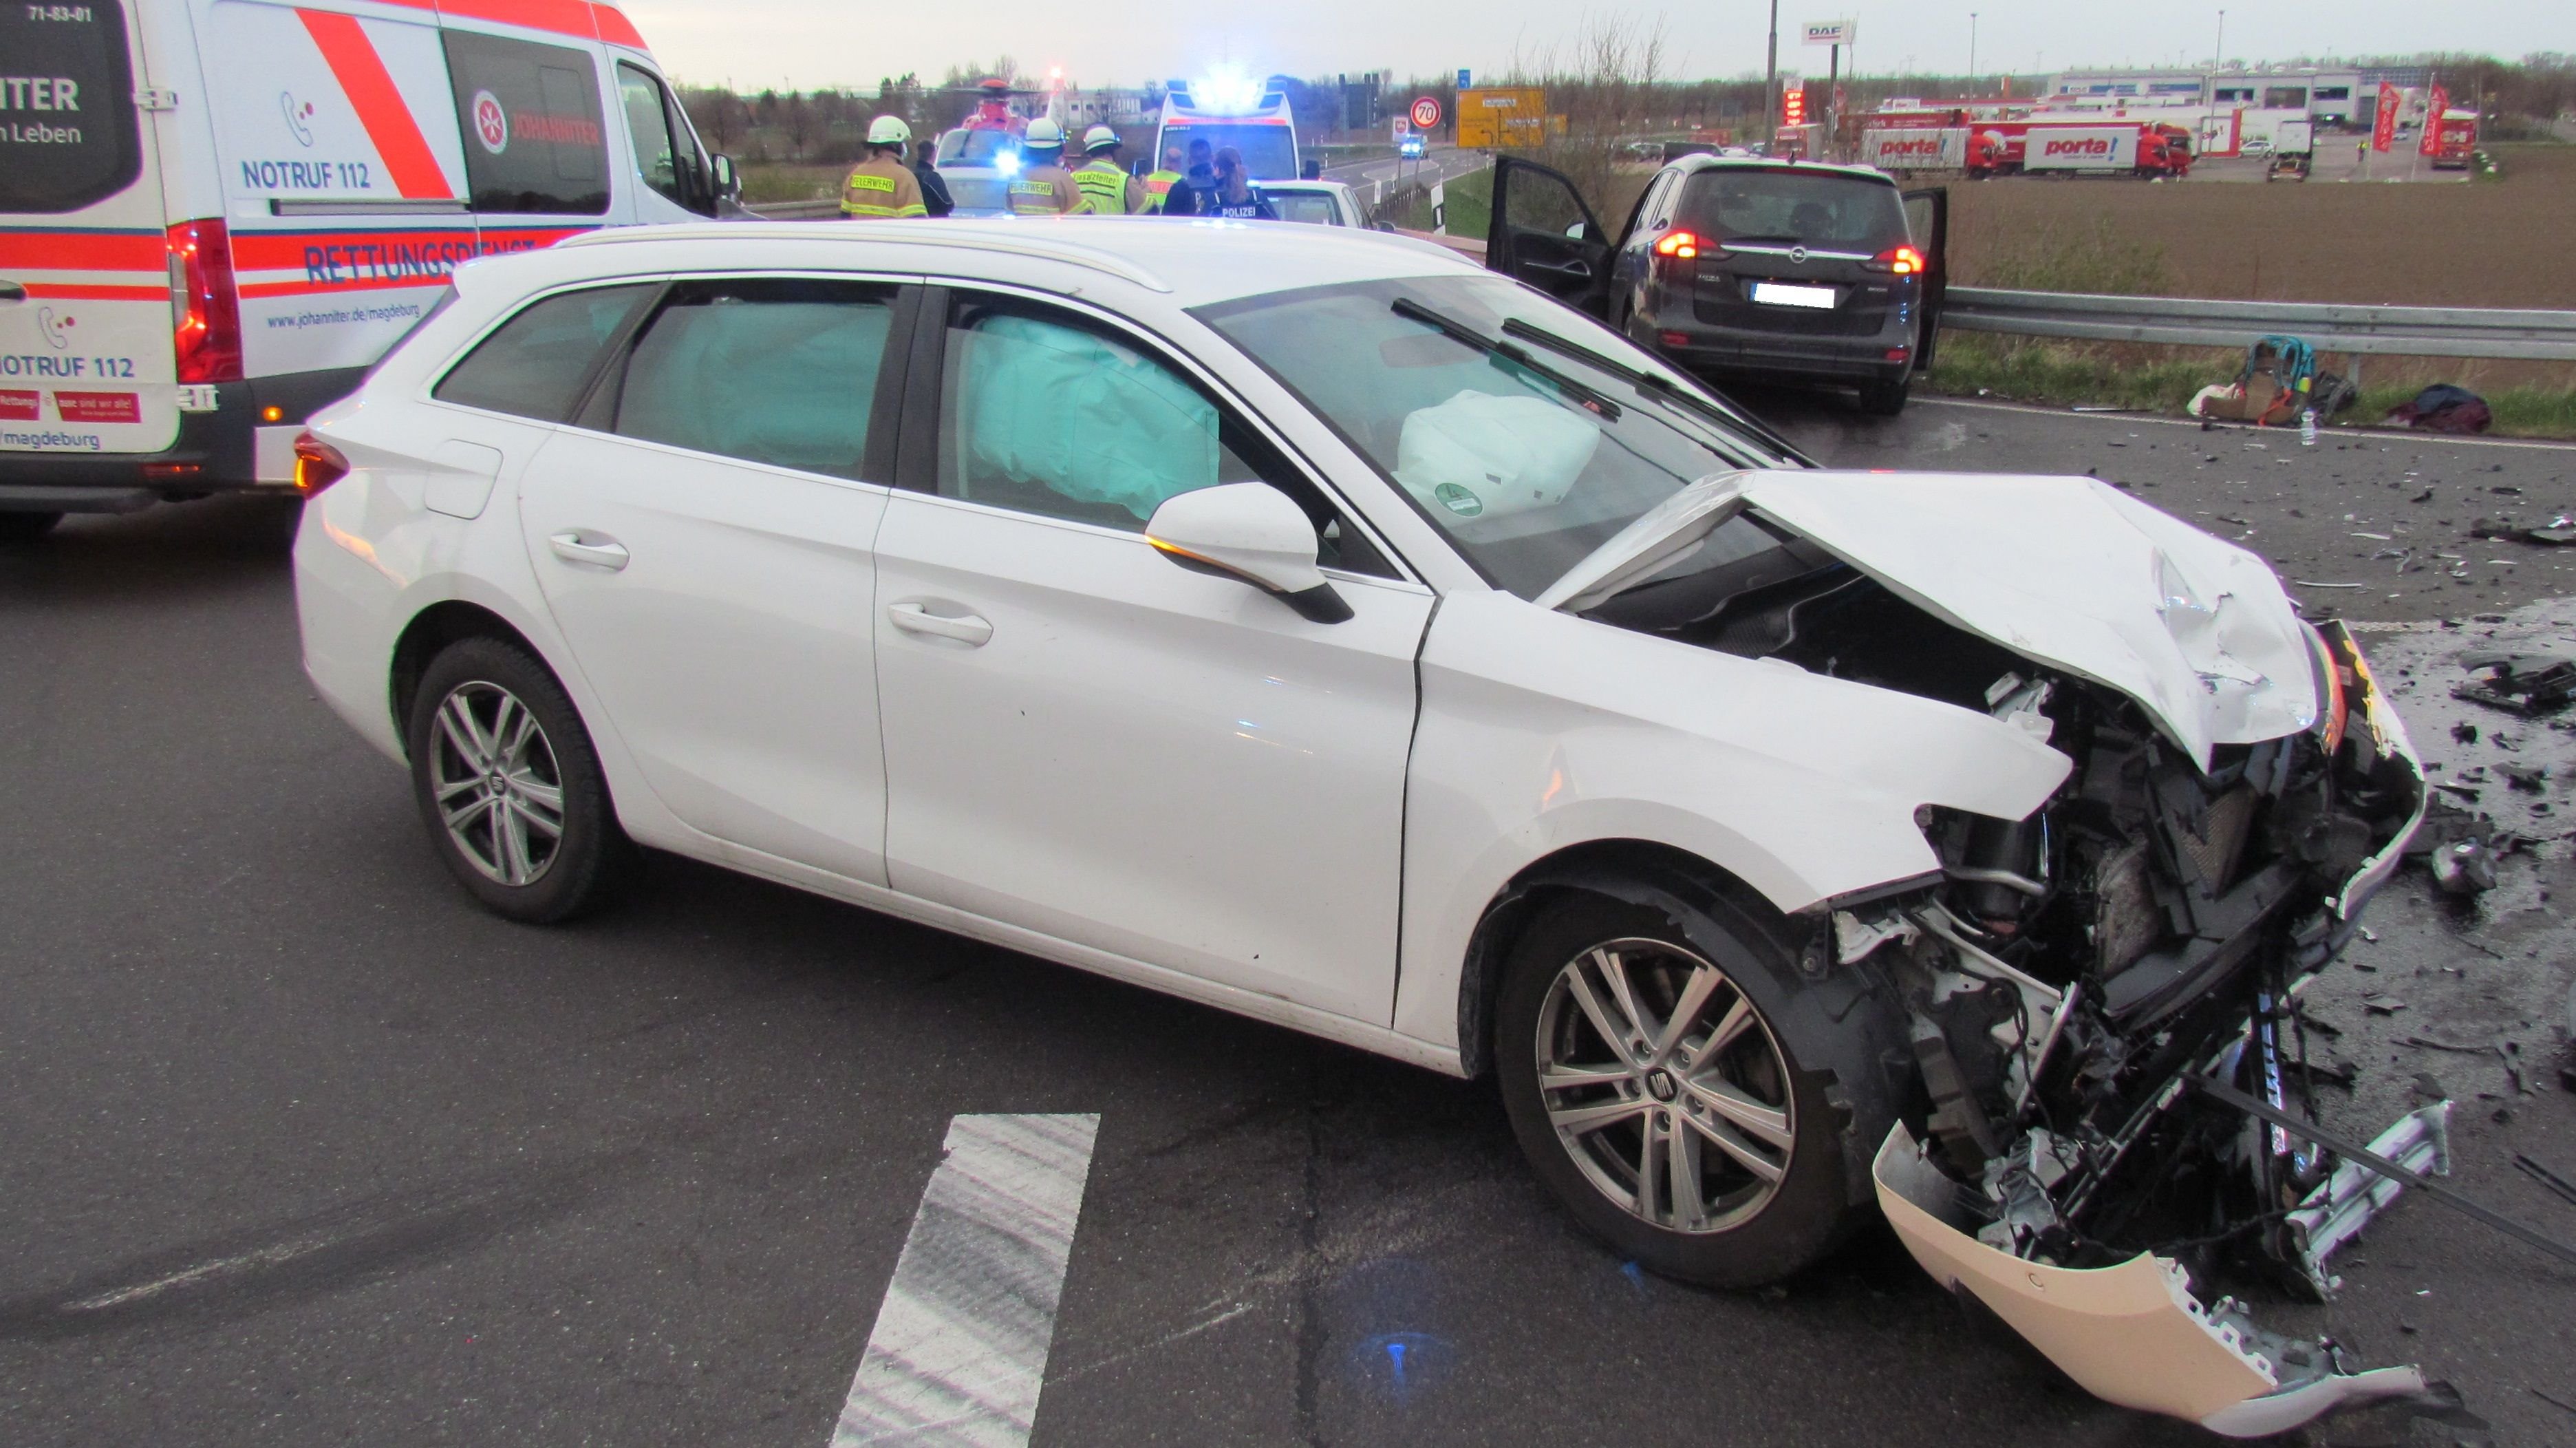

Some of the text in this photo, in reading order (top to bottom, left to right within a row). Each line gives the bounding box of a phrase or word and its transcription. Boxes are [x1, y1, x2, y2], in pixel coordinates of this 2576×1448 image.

[1809, 26, 1842, 35] DAF
[1418, 106, 1434, 120] 70
[12, 123, 82, 143] Leben
[512, 113, 599, 145] JOHANNITER
[2045, 137, 2118, 161] porta!
[242, 161, 372, 189] NOTRUF 112
[1223, 206, 1256, 217] POLIZEI
[305, 239, 535, 284] RETTUNGSDI
[268, 304, 420, 330] www.johanniter.de/magdeburg
[0, 354, 135, 377] OTRUF 112
